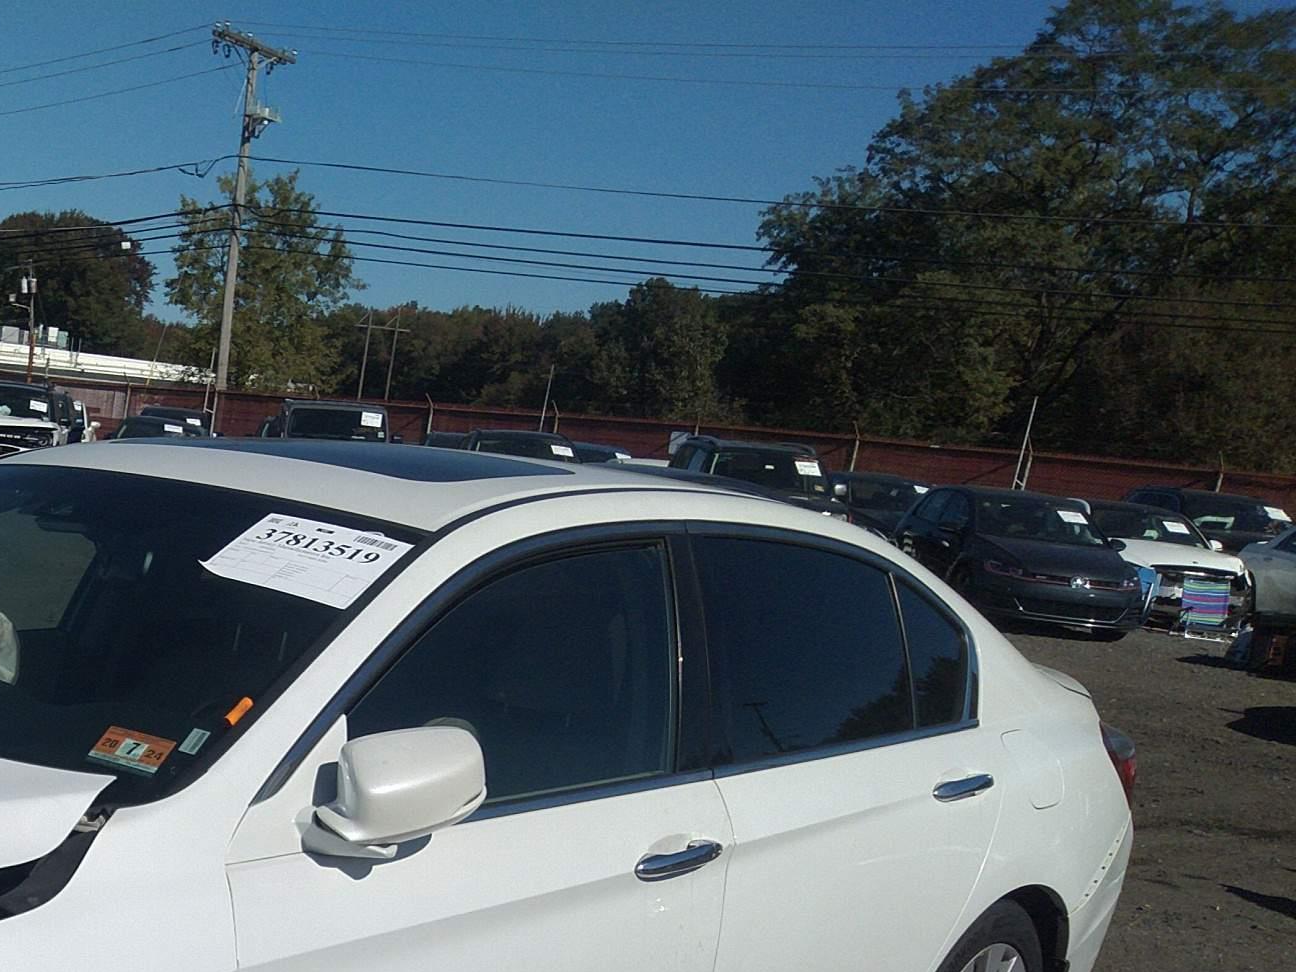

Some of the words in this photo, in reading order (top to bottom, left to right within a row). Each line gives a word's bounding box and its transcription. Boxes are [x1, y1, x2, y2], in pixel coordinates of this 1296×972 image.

[256, 528, 381, 566] 37813519
[126, 742, 140, 755] 7
[144, 749, 163, 761] 24
